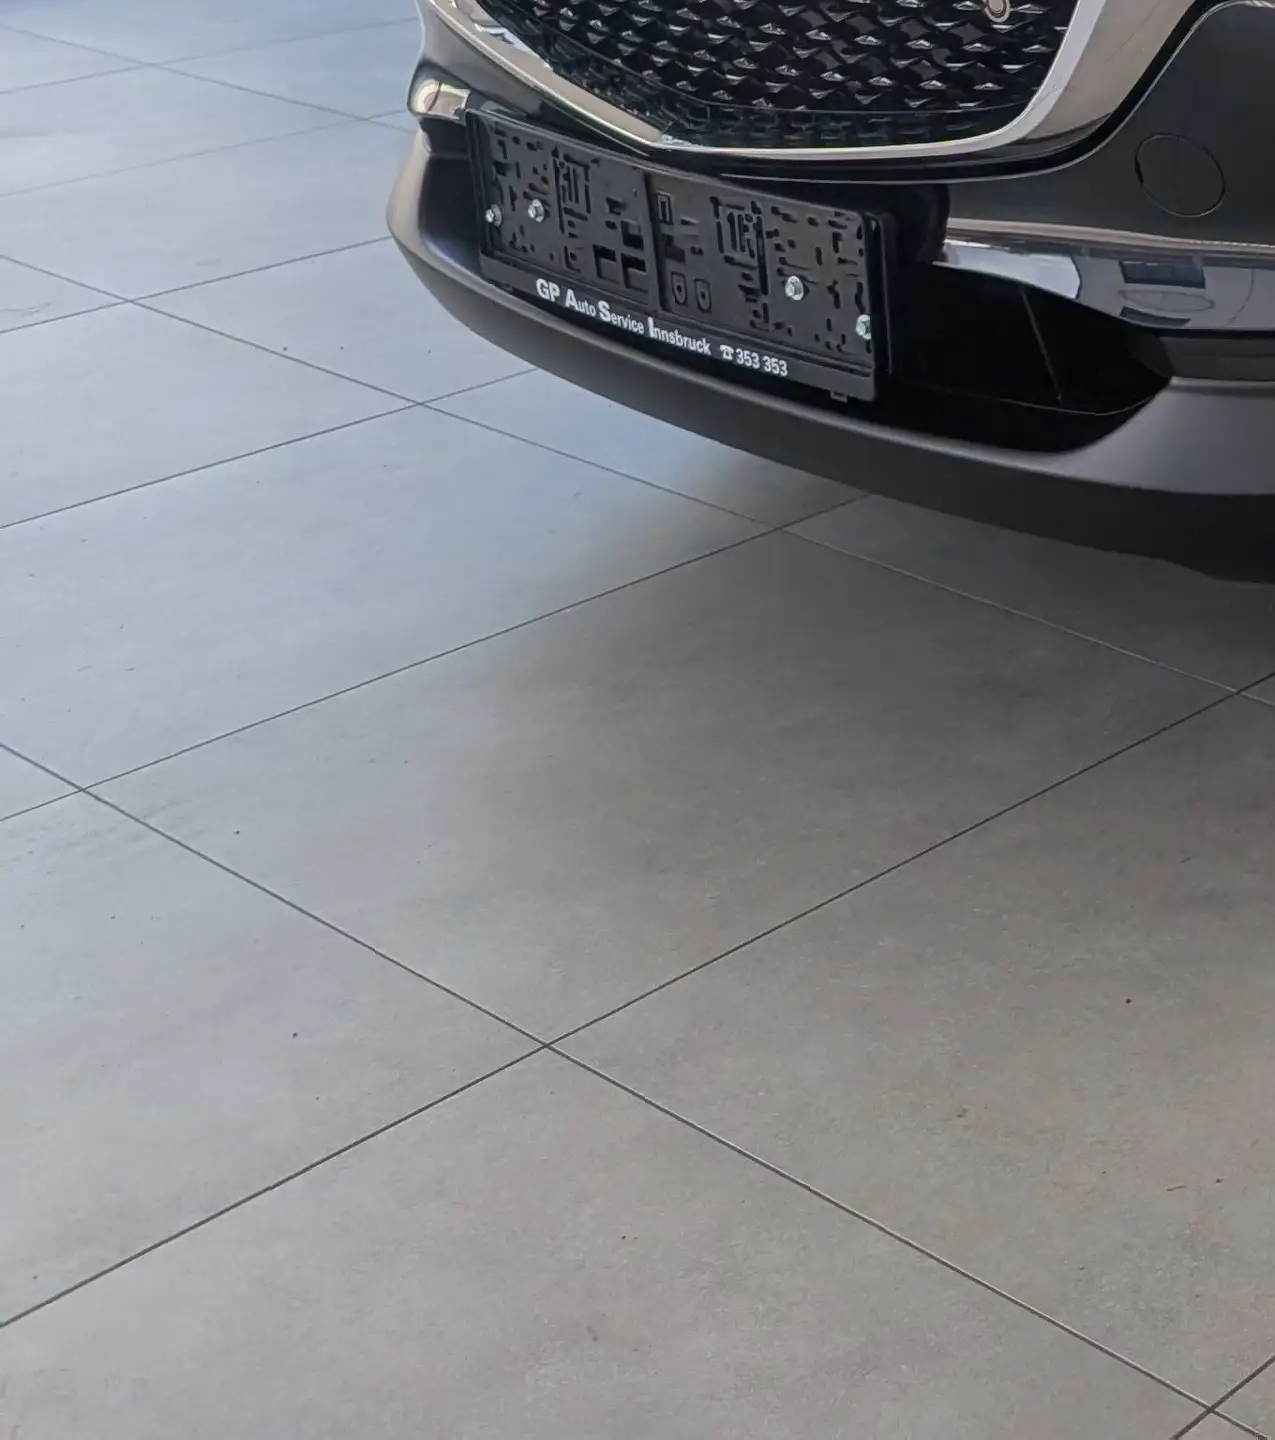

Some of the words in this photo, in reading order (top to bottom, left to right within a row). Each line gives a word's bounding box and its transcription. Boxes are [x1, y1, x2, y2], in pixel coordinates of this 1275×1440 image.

[536, 278, 560, 302] GP
[565, 289, 597, 317] Auto
[598, 300, 645, 335] Service
[648, 316, 712, 356] Innsbruck
[736, 348, 760, 369] 353
[763, 357, 789, 377] 353
